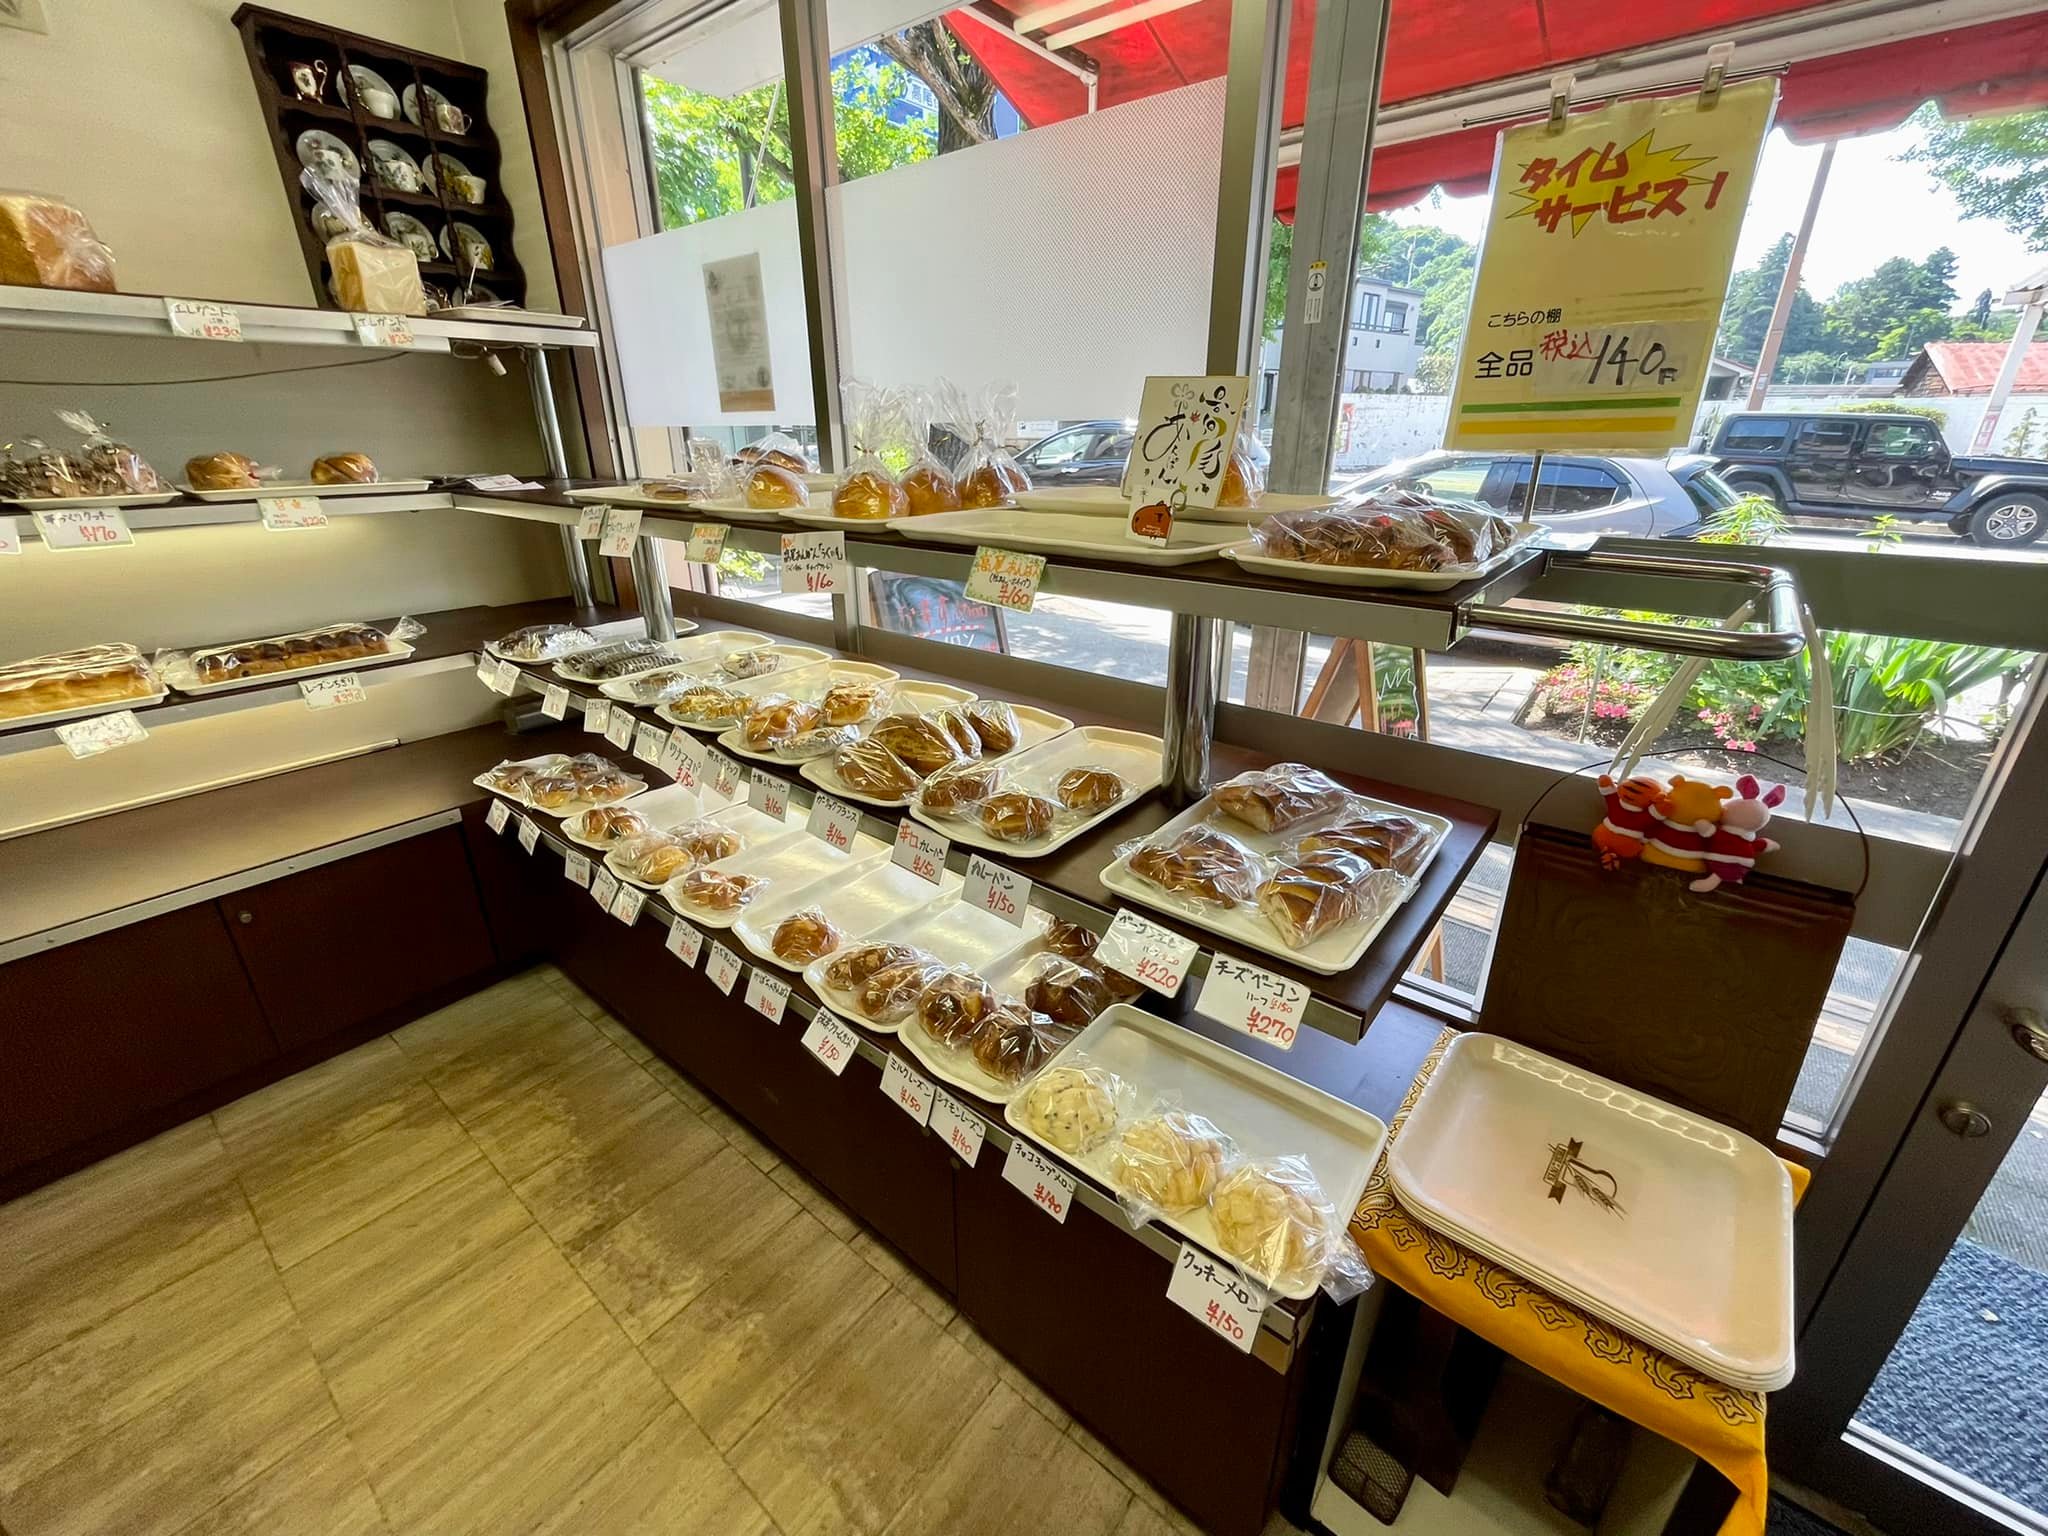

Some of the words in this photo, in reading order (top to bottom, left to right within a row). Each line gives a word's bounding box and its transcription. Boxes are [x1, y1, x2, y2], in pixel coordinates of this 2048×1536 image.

[1520, 141, 1630, 193] タイム
[1486, 307, 1563, 328] こちらの棚
[1474, 349, 1534, 379] 全品
[1539, 328, 1593, 362] 税込
[998, 583, 1031, 606] ¥160
[970, 860, 1015, 890] カレーパン
[987, 886, 1016, 914] ¥150
[1135, 956, 1178, 990] ¥220
[1214, 960, 1300, 1002] チーズベーコン
[1246, 1006, 1295, 1043] ¥270
[817, 1035, 840, 1061] ¥150
[900, 1085, 922, 1113] ¥150
[951, 1125, 973, 1156] ¥140
[1033, 1181, 1062, 1215] ¥140
[1205, 1298, 1244, 1340] ¥150
